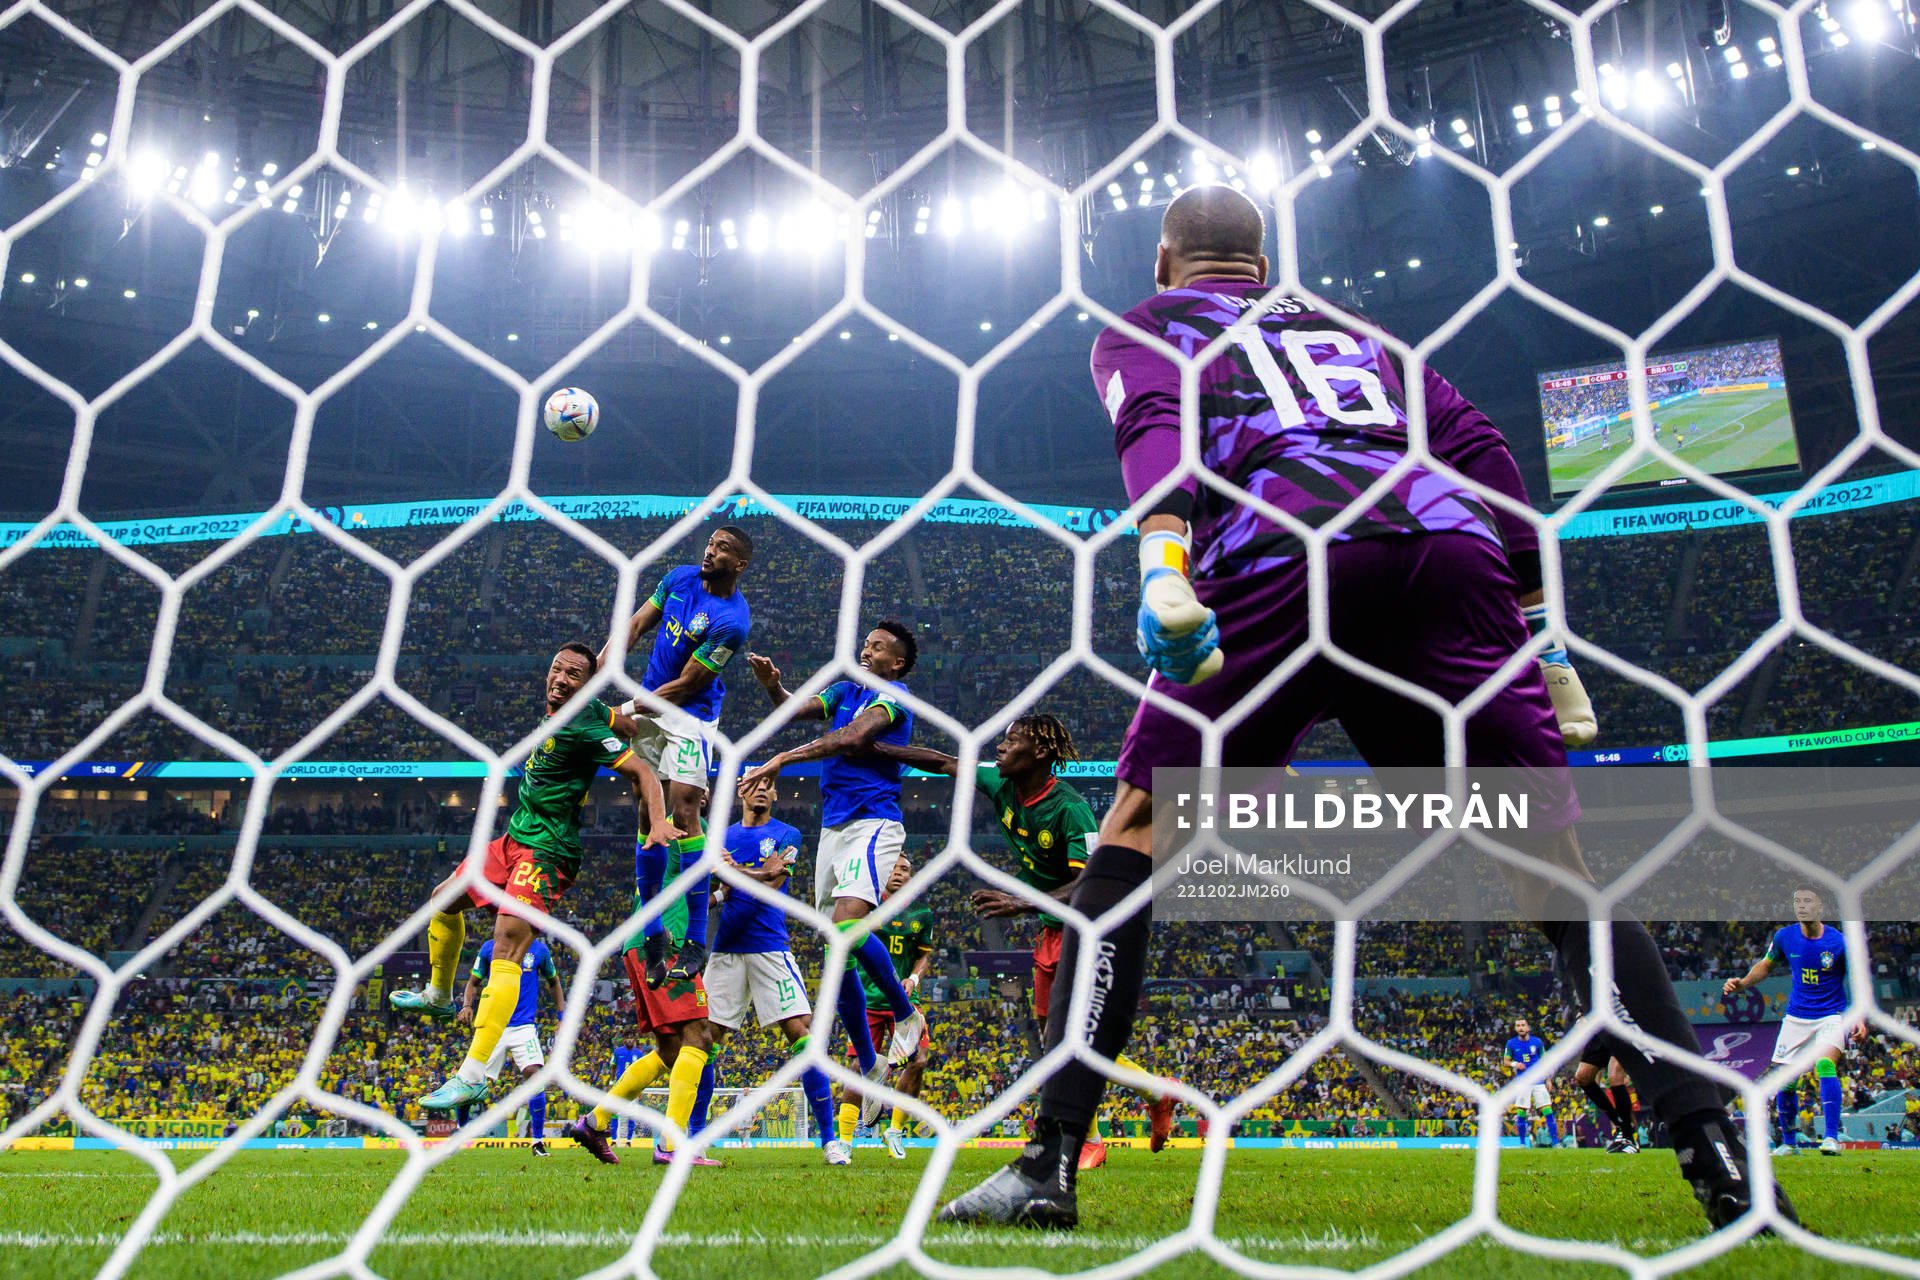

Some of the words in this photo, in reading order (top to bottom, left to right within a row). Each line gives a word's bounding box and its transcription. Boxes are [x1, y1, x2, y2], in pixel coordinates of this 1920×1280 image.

[1227, 324, 1397, 429] 16
[1595, 375, 1611, 383] CMR
[1651, 367, 1667, 375] BRA
[409, 507, 440, 519] FIFA
[442, 505, 480, 517] WOR
[796, 502, 826, 513] FIFA
[829, 502, 880, 514] WORLD
[882, 503, 910, 515] CUP
[1613, 515, 1648, 529] FIFA
[1650, 509, 1710, 526] WORLD
[1712, 506, 1745, 520] CUP
[6, 529, 32, 541] FIF
[42, 529, 91, 541] WORL
[1788, 736, 1812, 748] FIFA
[1814, 733, 1853, 746] WORLD
[1854, 731, 1875, 742] CUP
[677, 739, 700, 767] 24
[1594, 753, 1621, 763] 16:48
[91, 765, 117, 774] 16:48
[282, 765, 317, 774] WORLD
[318, 765, 337, 774] CUP
[1068, 765, 1088, 774] CUP
[513, 861, 542, 893] 24
[841, 858, 862, 881] 14
[889, 935, 904, 955] 15
[1801, 967, 1819, 985] 26
[775, 978, 796, 1002] 15
[177, 1141, 223, 1149] HUNG
[475, 1141, 551, 1149] CHILDRN
[1304, 1141, 1335, 1149] END
[1337, 1140, 1398, 1149] HUNGER
